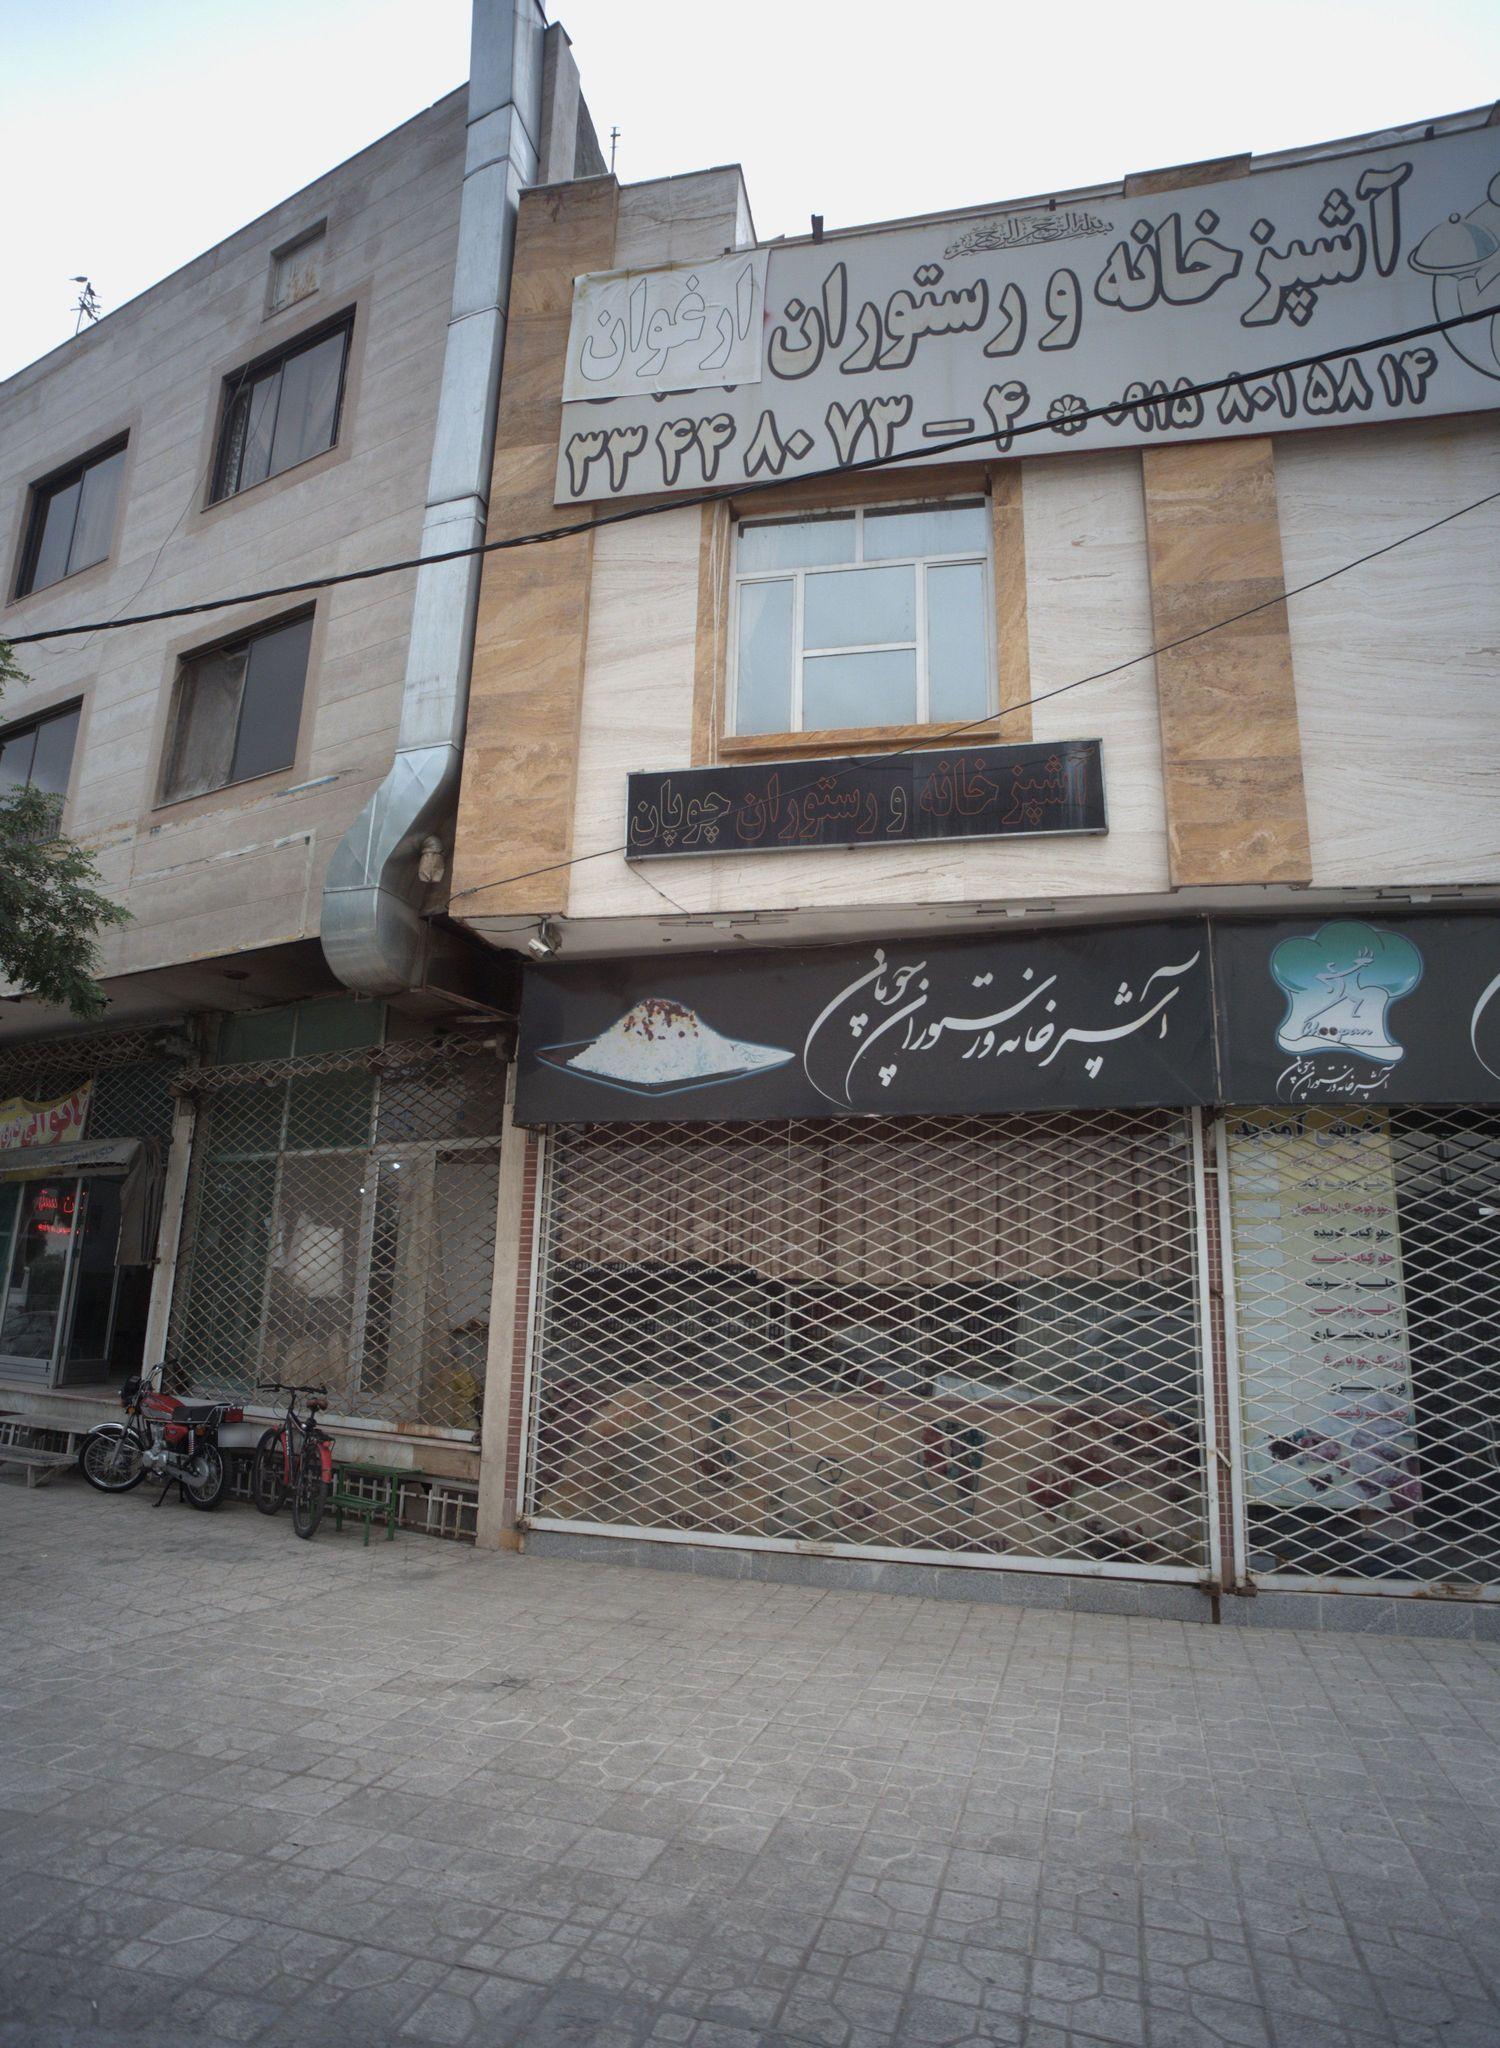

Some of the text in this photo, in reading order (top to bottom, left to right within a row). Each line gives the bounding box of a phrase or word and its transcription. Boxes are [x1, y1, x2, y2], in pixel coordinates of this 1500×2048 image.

[579, 263, 753, 382] ارغوان
[768, 262, 1027, 380] رستوران
[1038, 268, 1083, 351] و
[631, 779, 732, 847] چوپان
[736, 773, 878, 842] رستوران
[887, 785, 907, 832] و
[803, 948, 928, 1111] چوپان
[845, 971, 1057, 1104] رستوران
[1275, 1055, 1315, 1104] چوپان
